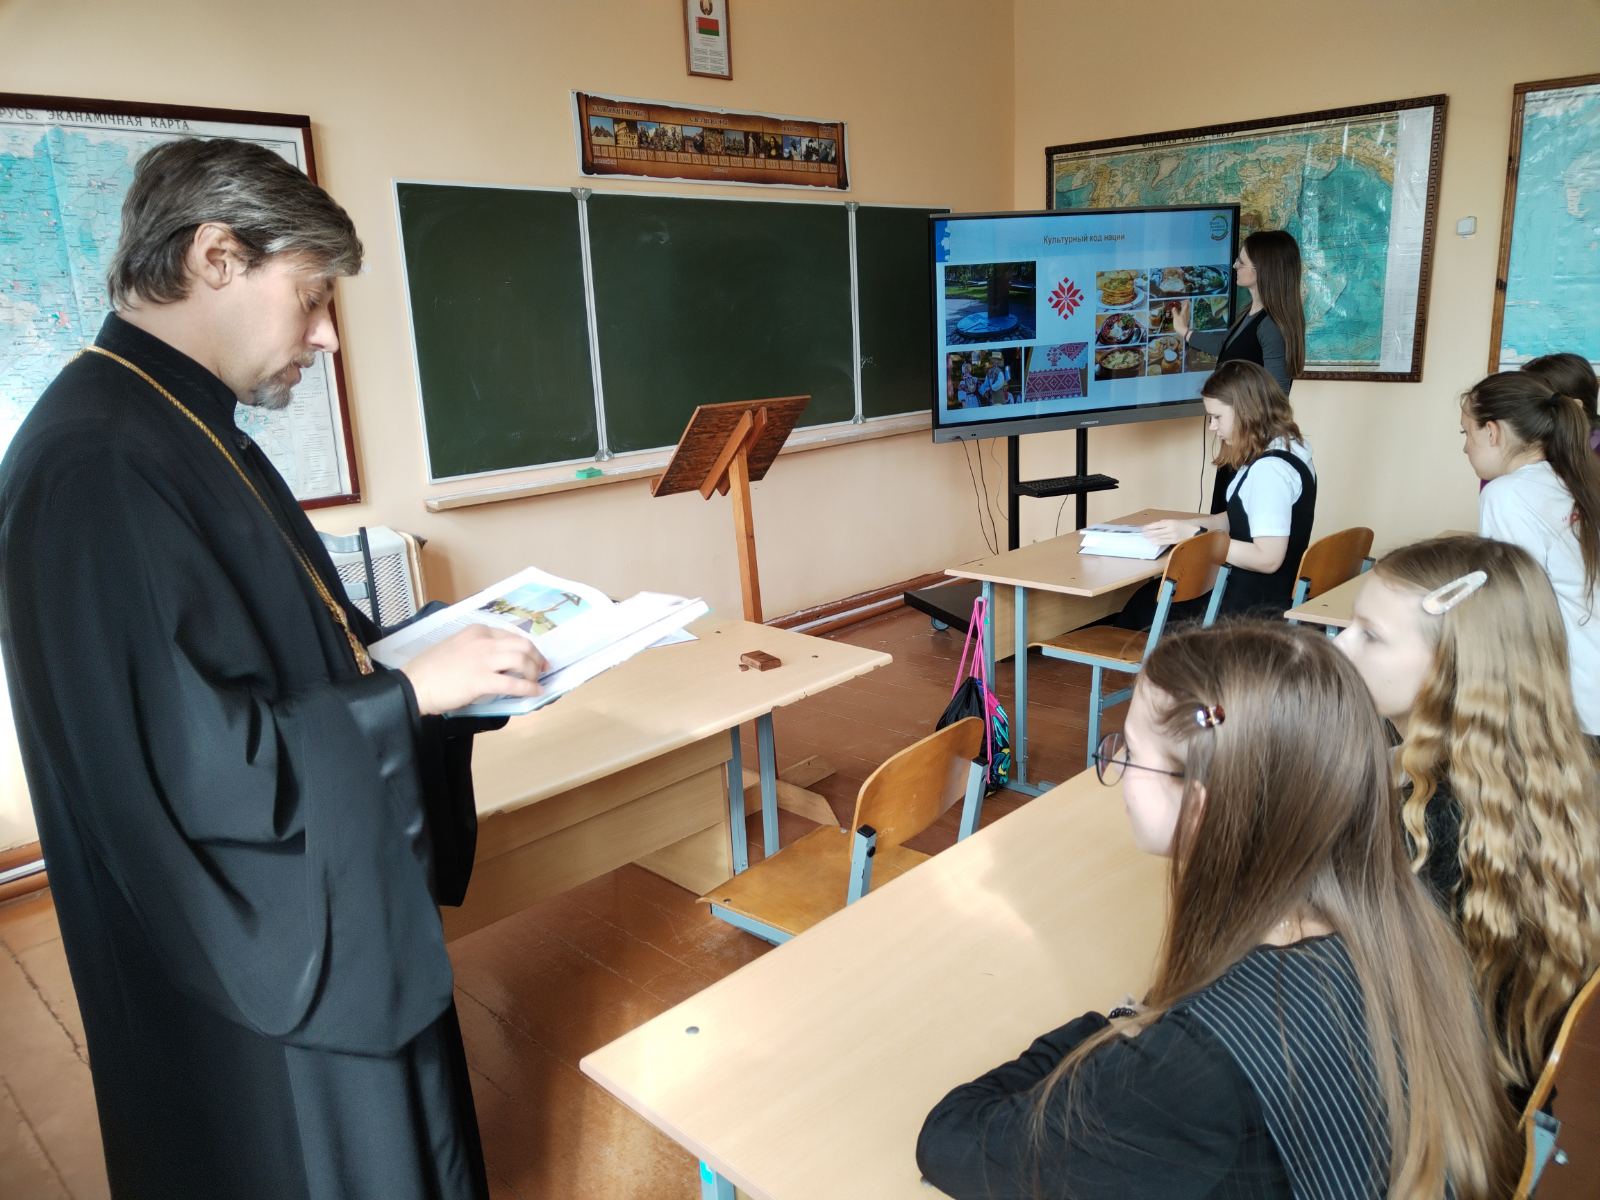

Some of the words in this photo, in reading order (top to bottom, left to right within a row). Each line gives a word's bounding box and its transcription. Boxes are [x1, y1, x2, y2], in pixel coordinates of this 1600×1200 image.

[48, 110, 143, 127] ЭКАНАМІЧНАЯ
[150, 119, 190, 130] КАРТА
[1043, 233, 1088, 246] Культурный
[1089, 234, 1102, 243] код
[1104, 233, 1125, 242] нации
